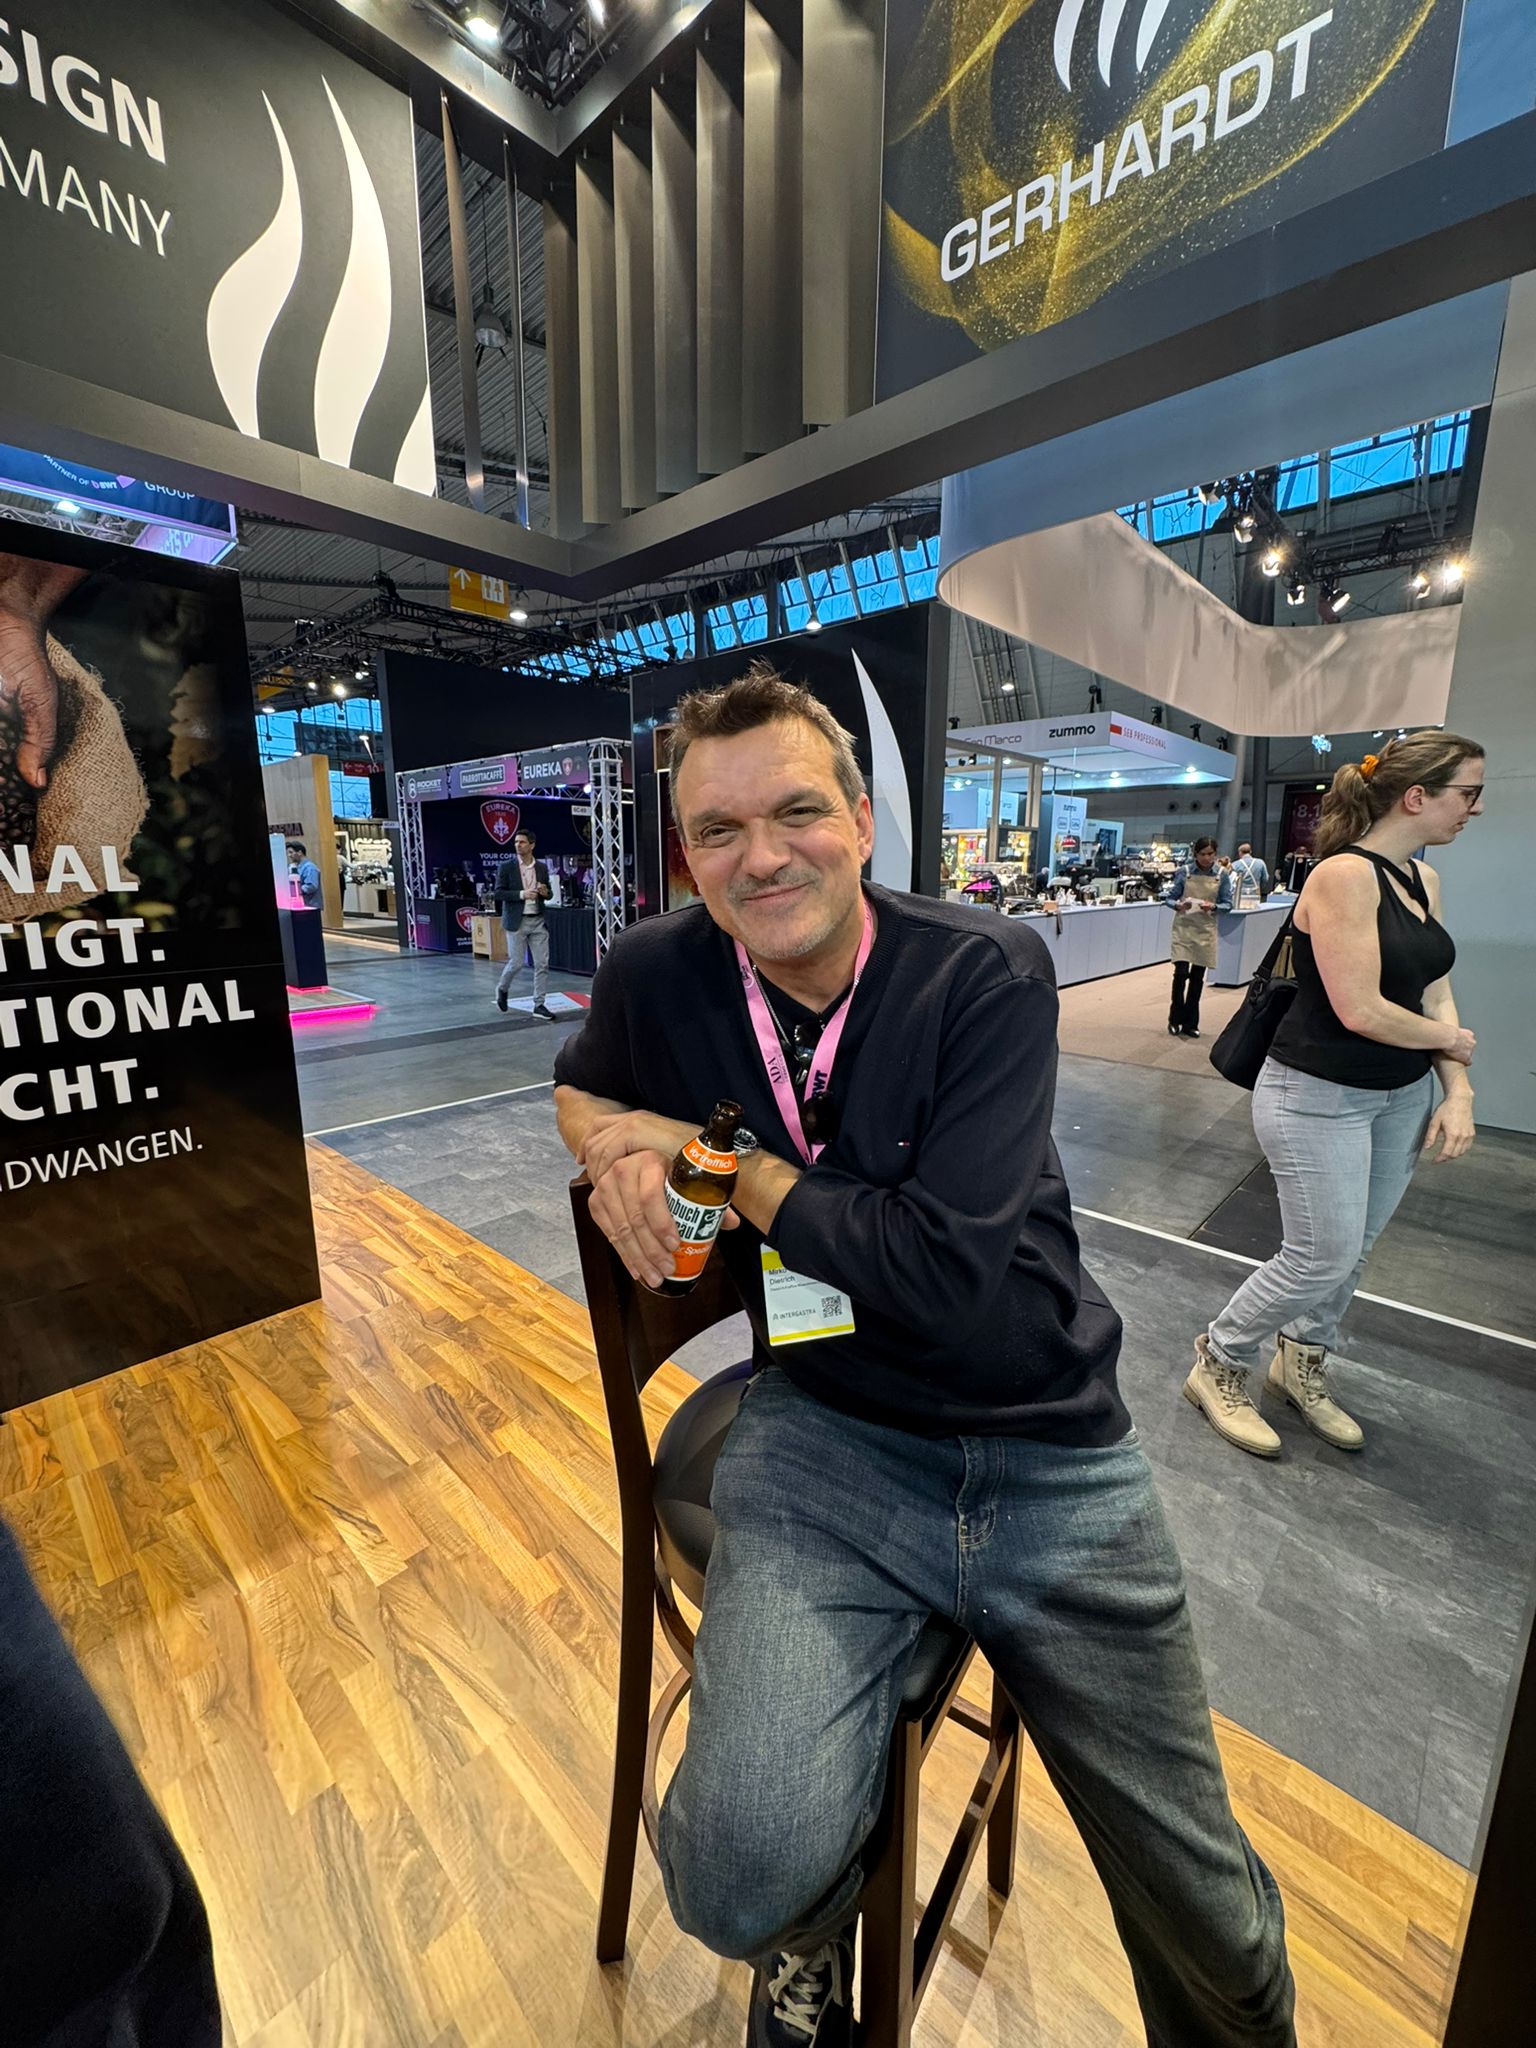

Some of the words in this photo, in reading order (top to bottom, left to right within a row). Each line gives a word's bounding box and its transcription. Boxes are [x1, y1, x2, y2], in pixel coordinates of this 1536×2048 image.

[940, 9, 1333, 282] GERHARDT
[0, 135, 171, 257] MANY
[1049, 725, 1096, 738] zummo
[523, 761, 562, 779] EUREKA
[485, 803, 516, 815] EUREKA
[0, 1126, 203, 1192] DWANGEN.
[689, 1145, 733, 1169] Vortrefflich
